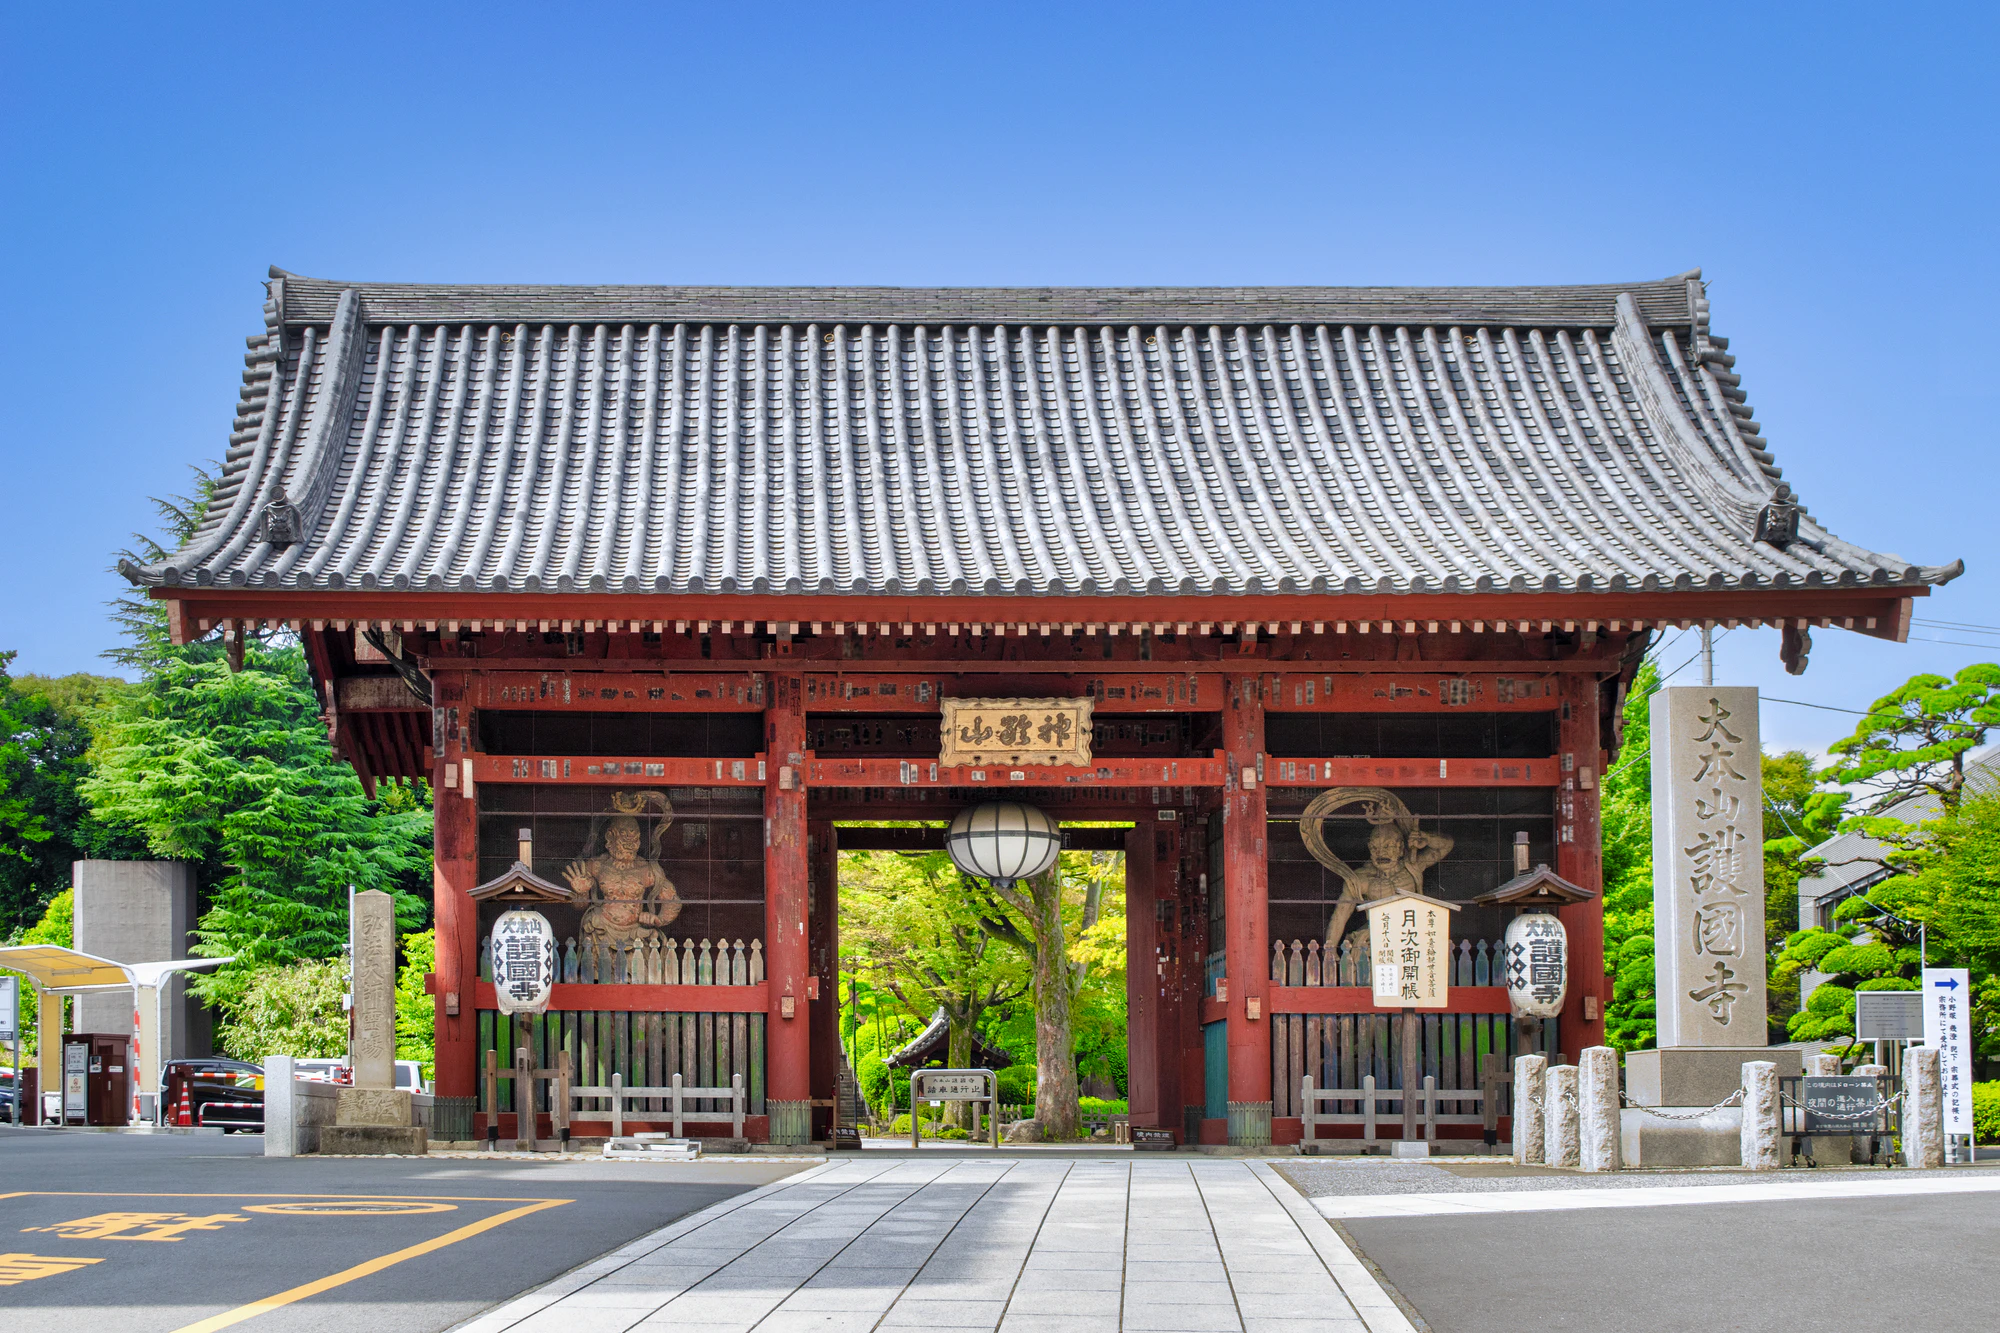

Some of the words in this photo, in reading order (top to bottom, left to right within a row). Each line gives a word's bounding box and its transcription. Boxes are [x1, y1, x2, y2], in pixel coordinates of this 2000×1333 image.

[1684, 697, 1750, 1026] 大本山護國寺
[502, 917, 543, 935] 大本山
[1400, 909, 1421, 1001] 月次御開帳
[1525, 920, 1563, 938] 大本山
[505, 935, 542, 1002] 護國寺
[1529, 938, 1564, 1005] 護國寺
